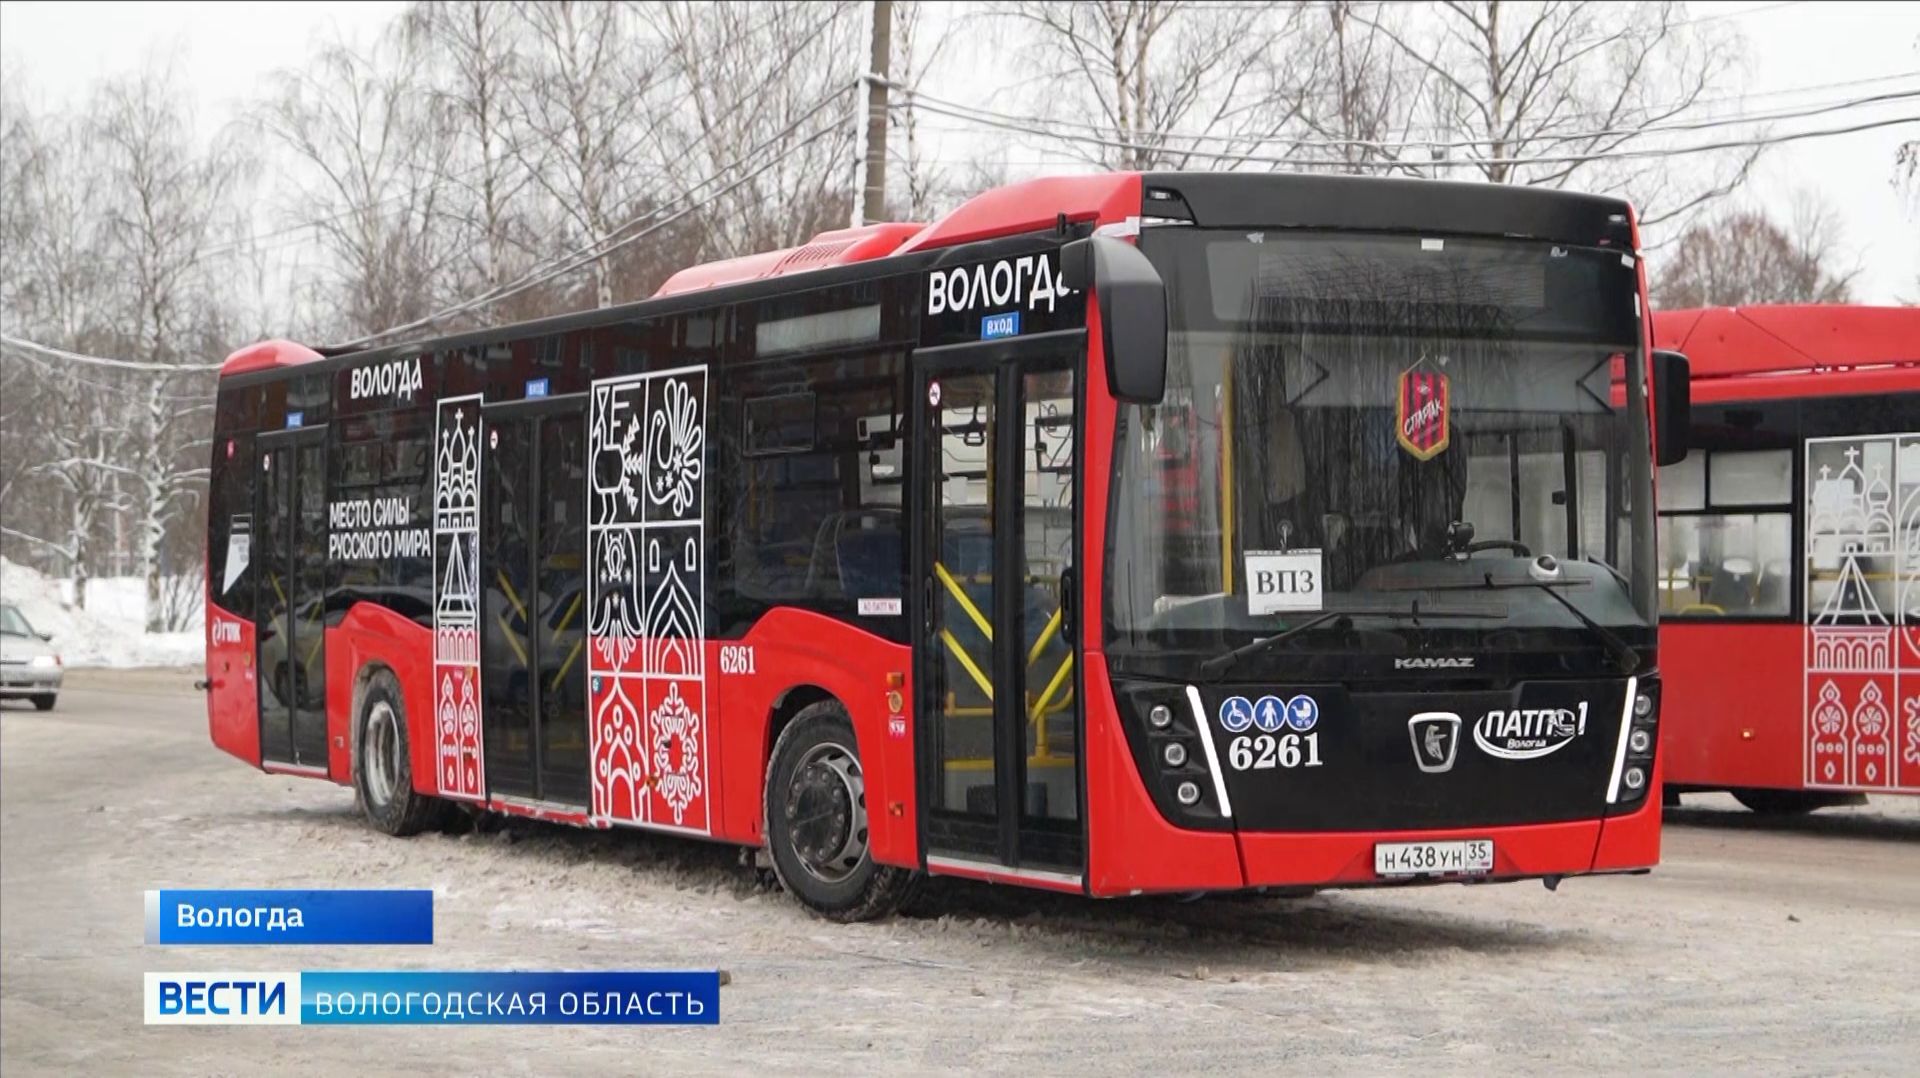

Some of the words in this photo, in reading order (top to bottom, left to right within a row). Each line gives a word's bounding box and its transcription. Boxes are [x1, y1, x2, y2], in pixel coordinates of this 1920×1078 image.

[986, 316, 1013, 335] ВХОД
[329, 499, 371, 529] МЕСТО
[373, 496, 410, 526] СИЛЫ
[329, 530, 392, 560] РУССКОГО
[394, 528, 431, 558] МИРА
[720, 645, 756, 675] 6261
[1484, 709, 1555, 738] ПАТП
[1228, 732, 1323, 771] 6261
[1507, 738, 1546, 749] Вологда
[1468, 842, 1487, 860] 35
